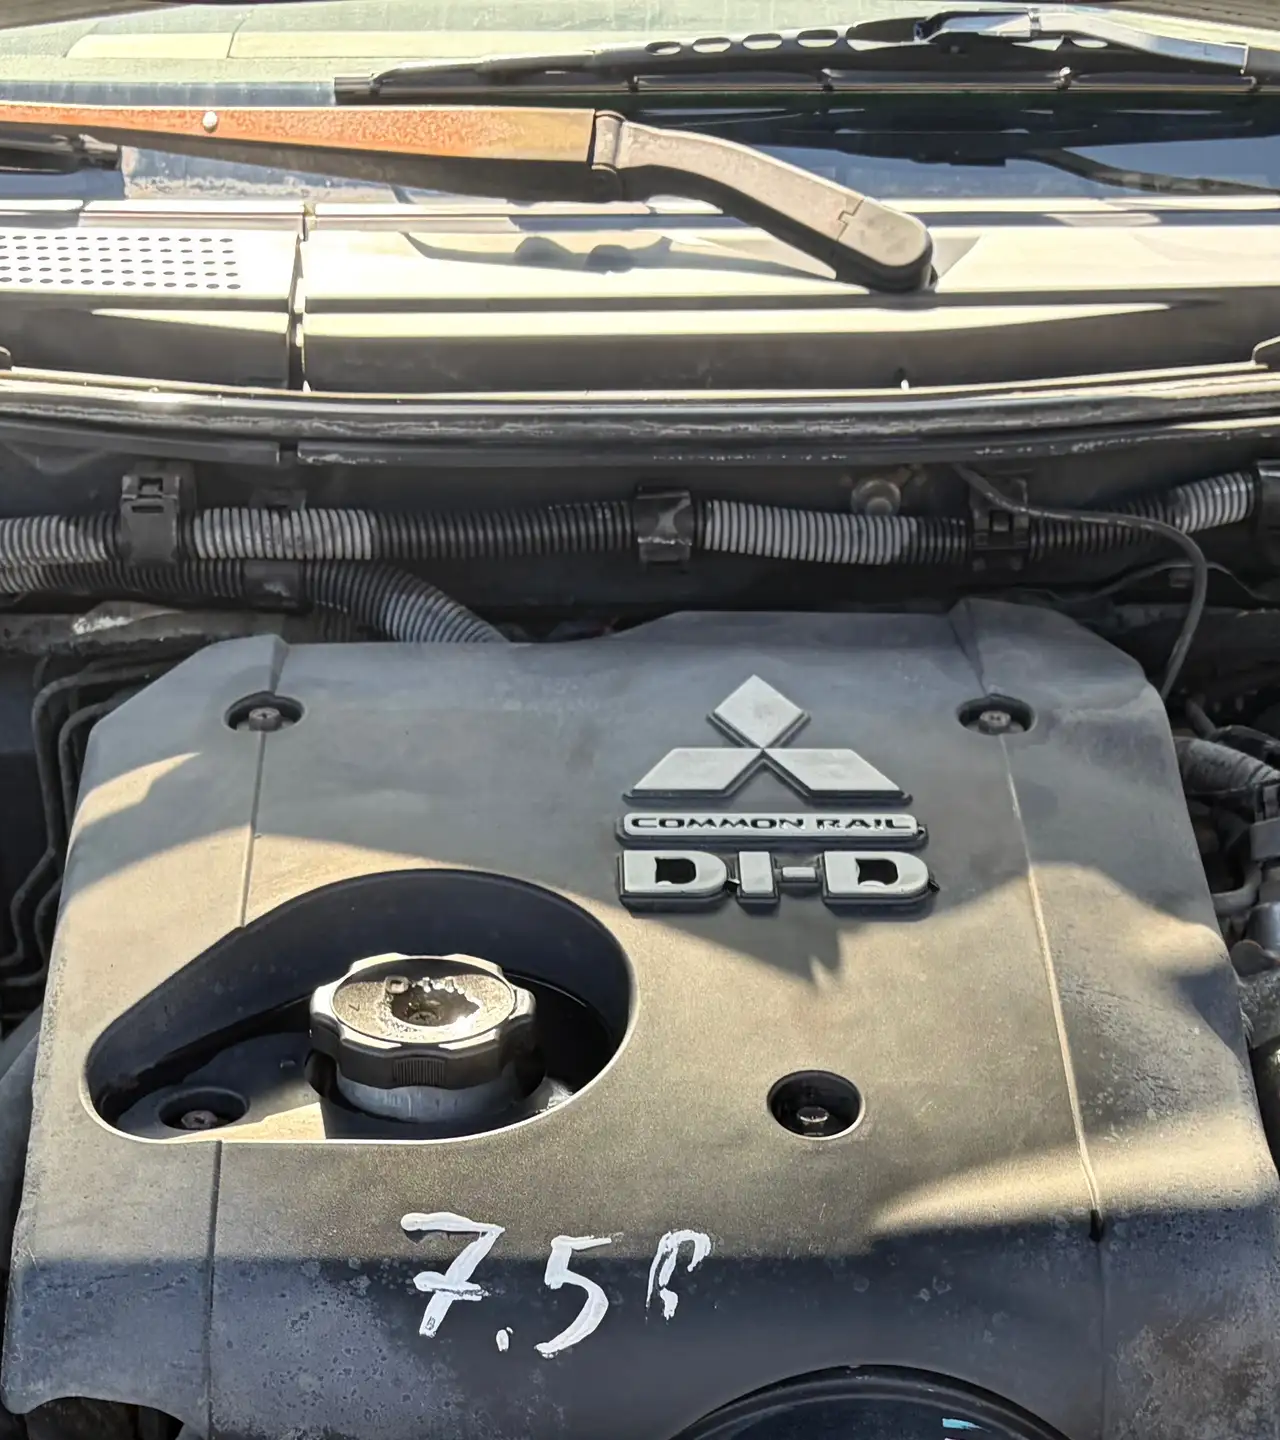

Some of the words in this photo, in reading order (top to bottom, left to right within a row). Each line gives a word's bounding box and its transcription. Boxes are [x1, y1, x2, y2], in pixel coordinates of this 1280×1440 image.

[631, 817, 804, 831] COMMON
[816, 817, 912, 831] RAIL
[623, 850, 929, 895] DI-D
